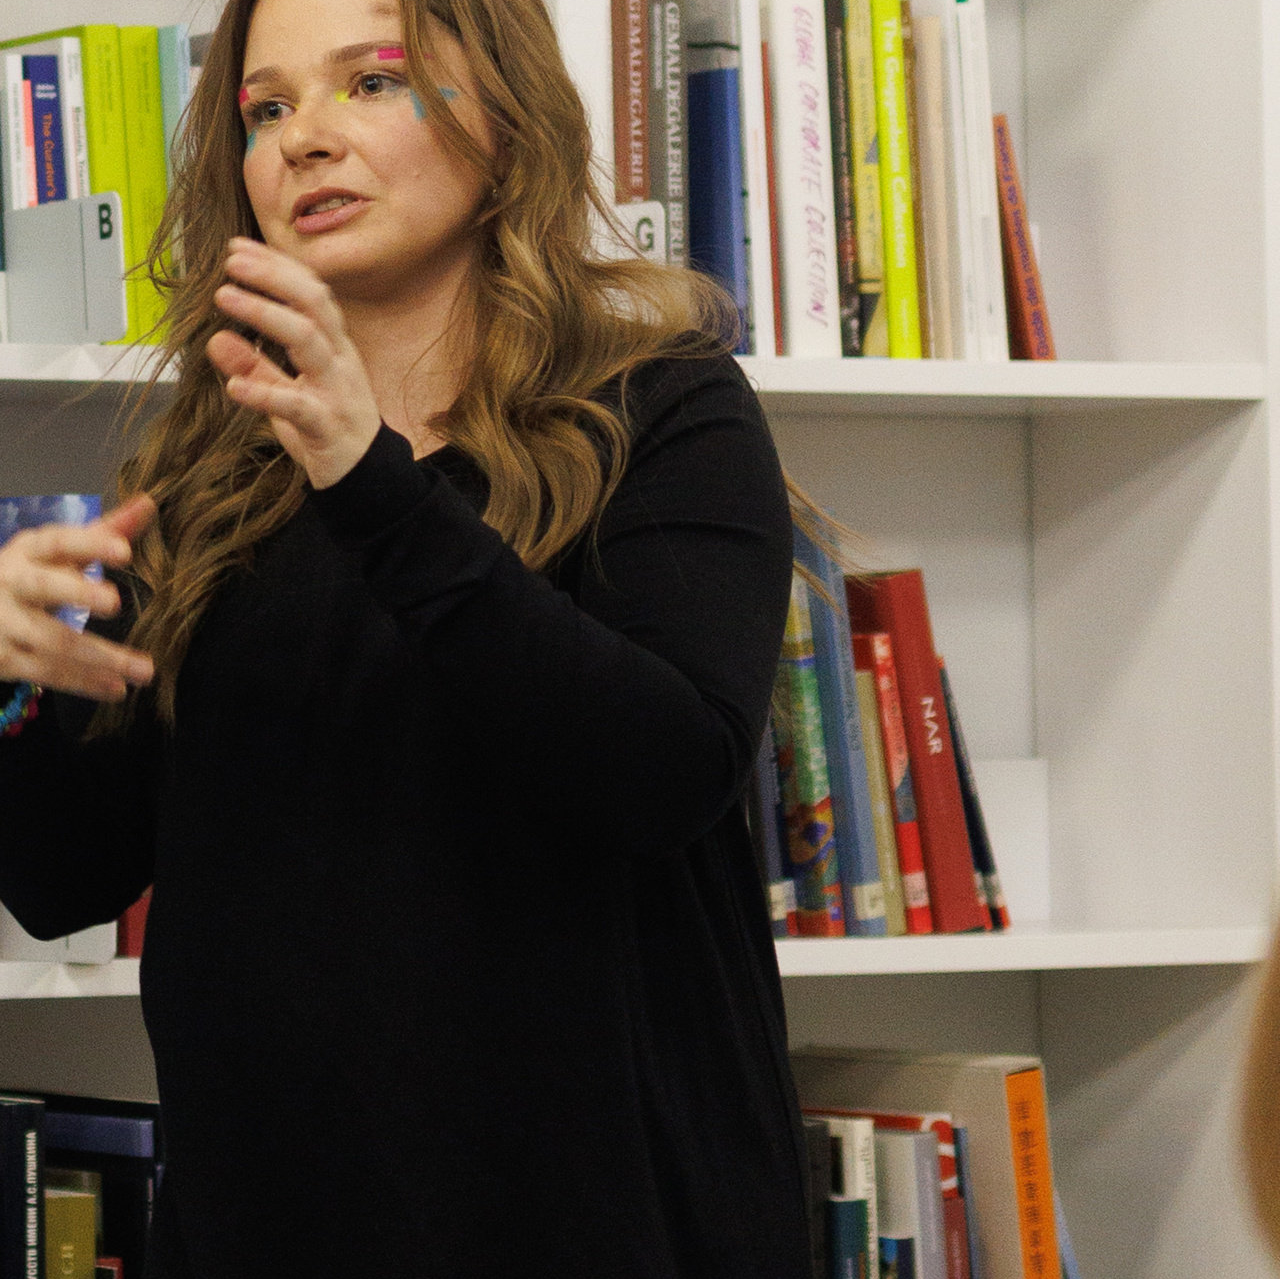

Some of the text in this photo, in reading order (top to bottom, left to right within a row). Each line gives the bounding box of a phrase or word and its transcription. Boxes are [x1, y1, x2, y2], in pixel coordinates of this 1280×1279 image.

[42, 113, 57, 198] The Curator's
[792, 6, 828, 328] GLOBAL CORPORATE COLLECTIONS
[879, 18, 909, 268] The Guggenheim Collection
[98, 204, 113, 240] B
[634, 217, 655, 253] G
[920, 695, 943, 755] NAR
[25, 1207, 37, 1246] ИМЕНИ
